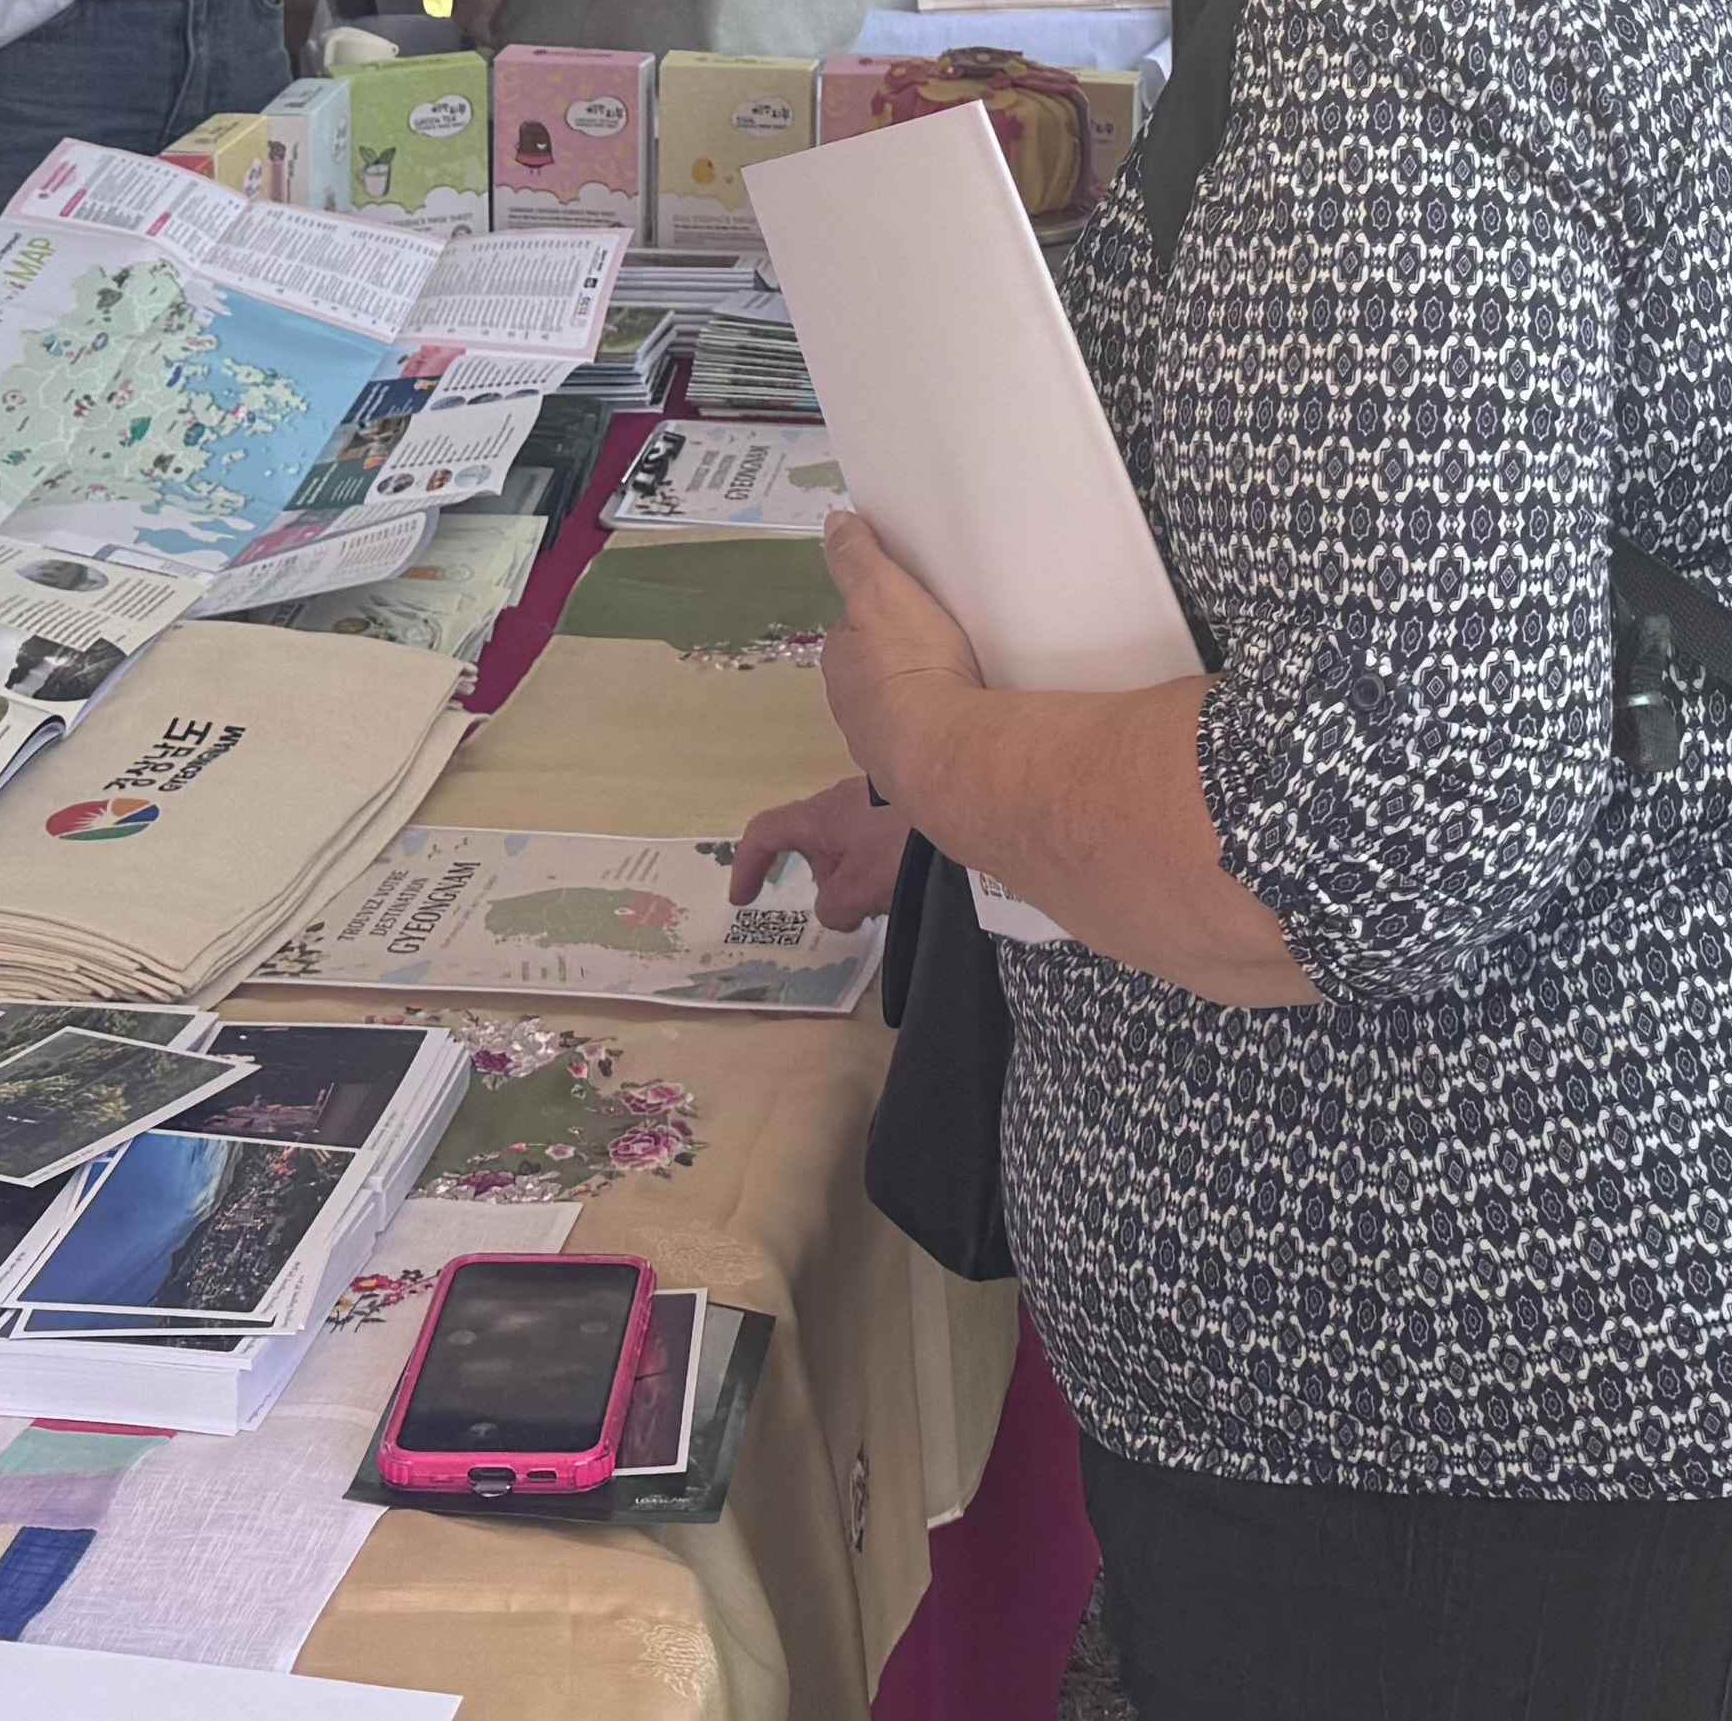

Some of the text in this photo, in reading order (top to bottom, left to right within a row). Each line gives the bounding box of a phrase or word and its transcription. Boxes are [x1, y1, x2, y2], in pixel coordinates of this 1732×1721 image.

[103, 717, 213, 791] 경상남도
[158, 725, 247, 793] GYEONGNAM
[337, 869, 409, 941] TROUVEZ VOTRE
[369, 877, 428, 938] DESTINATION
[386, 861, 481, 955] GYEONGNAM
